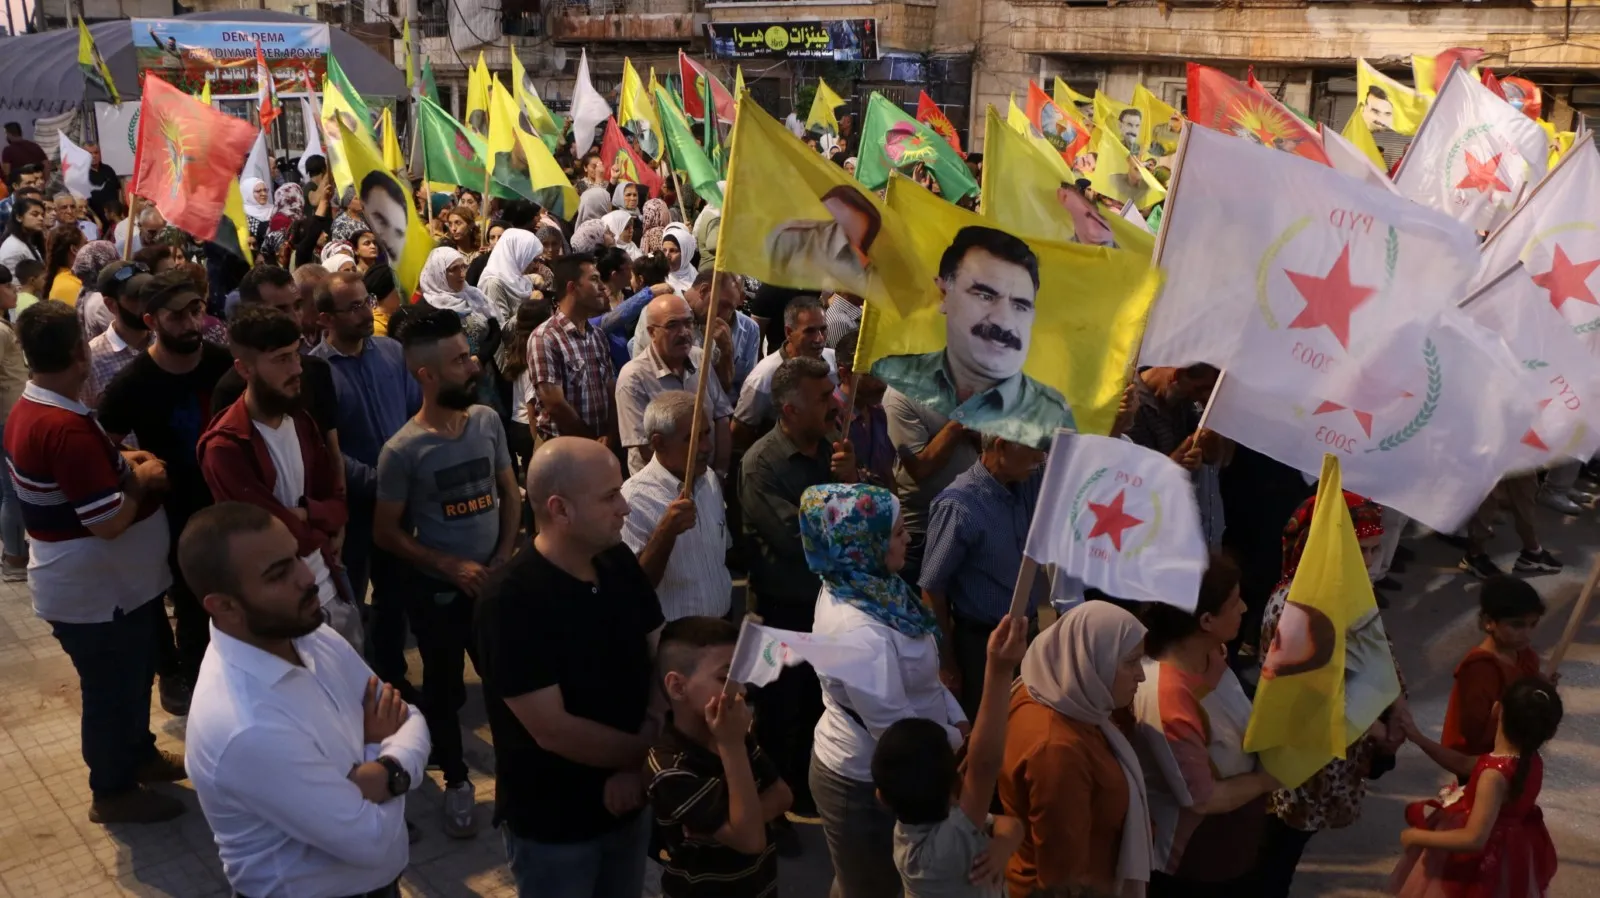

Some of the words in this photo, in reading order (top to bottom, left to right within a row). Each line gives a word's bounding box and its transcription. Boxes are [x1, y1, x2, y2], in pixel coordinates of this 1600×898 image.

[251, 32, 285, 43] DEMA
[1550, 375, 1581, 410] PYD
[446, 494, 493, 516] ROMER
